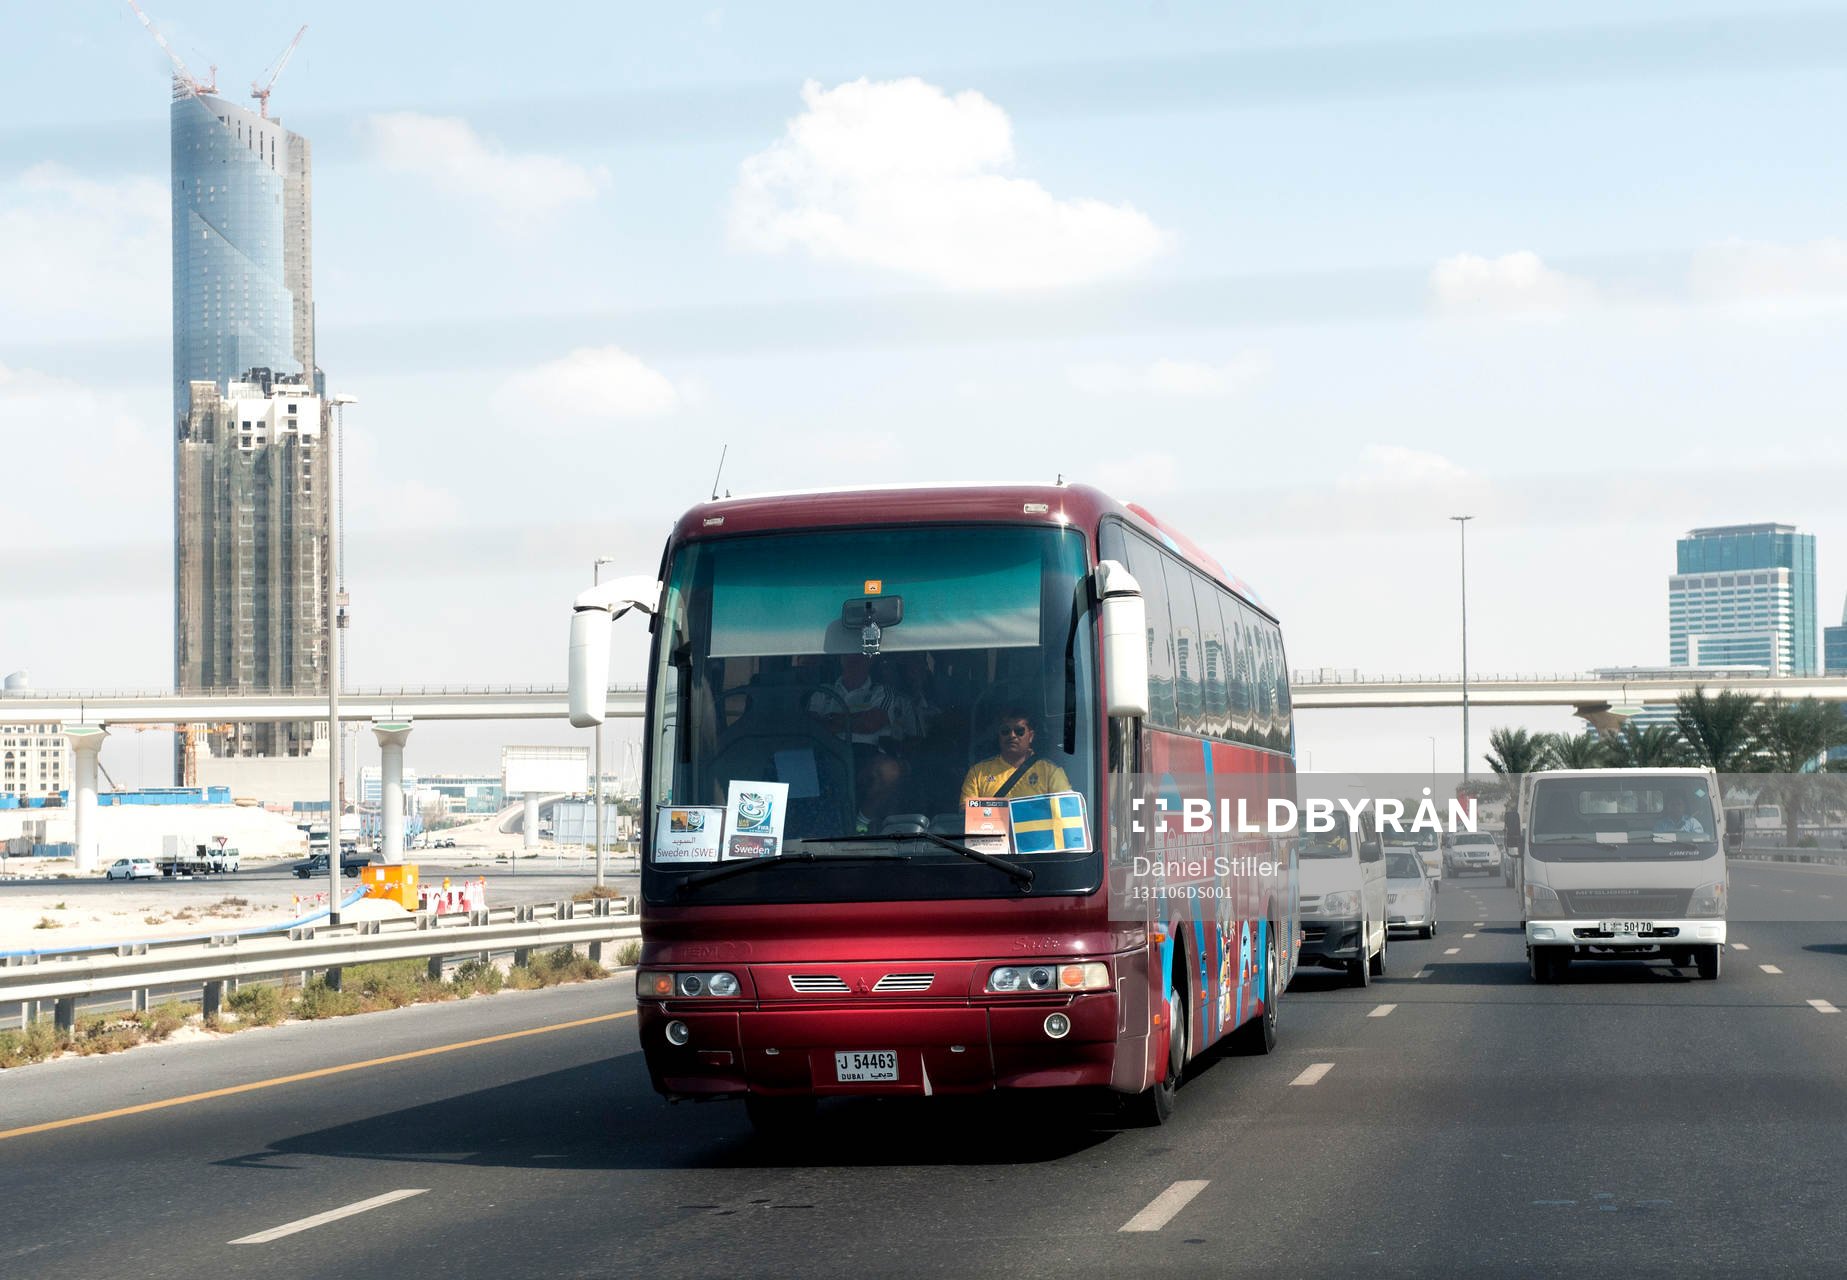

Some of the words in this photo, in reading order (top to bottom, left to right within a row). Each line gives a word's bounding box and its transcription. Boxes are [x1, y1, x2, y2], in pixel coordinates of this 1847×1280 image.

[657, 847, 689, 858] Sweden
[734, 843, 770, 855] Sweden
[840, 1055, 848, 1070] J
[854, 1053, 894, 1070] 54463
